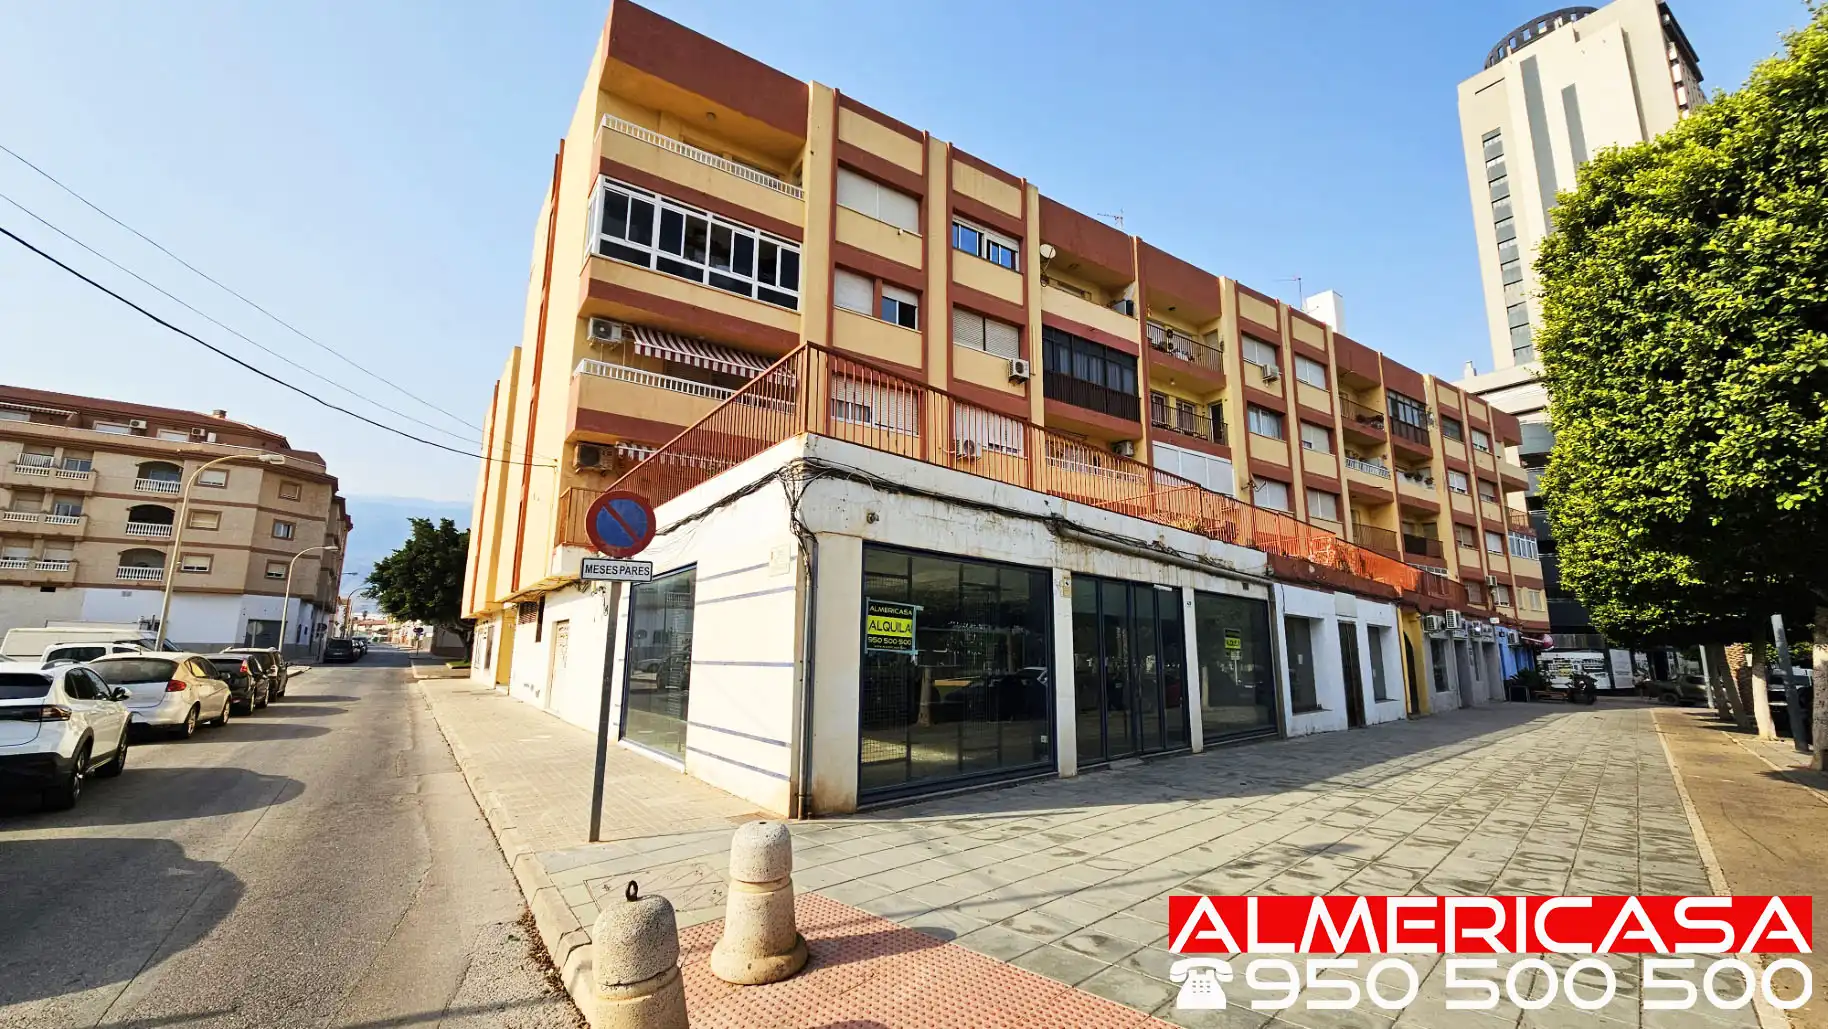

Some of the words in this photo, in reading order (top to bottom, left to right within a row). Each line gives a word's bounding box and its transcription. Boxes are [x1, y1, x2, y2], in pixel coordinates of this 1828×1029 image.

[585, 564, 618, 575] MESES
[619, 565, 650, 576] PARES
[869, 605, 913, 616] ALMERICASA
[868, 636, 883, 644] 950
[883, 637, 898, 645] 500
[898, 638, 912, 646] 500
